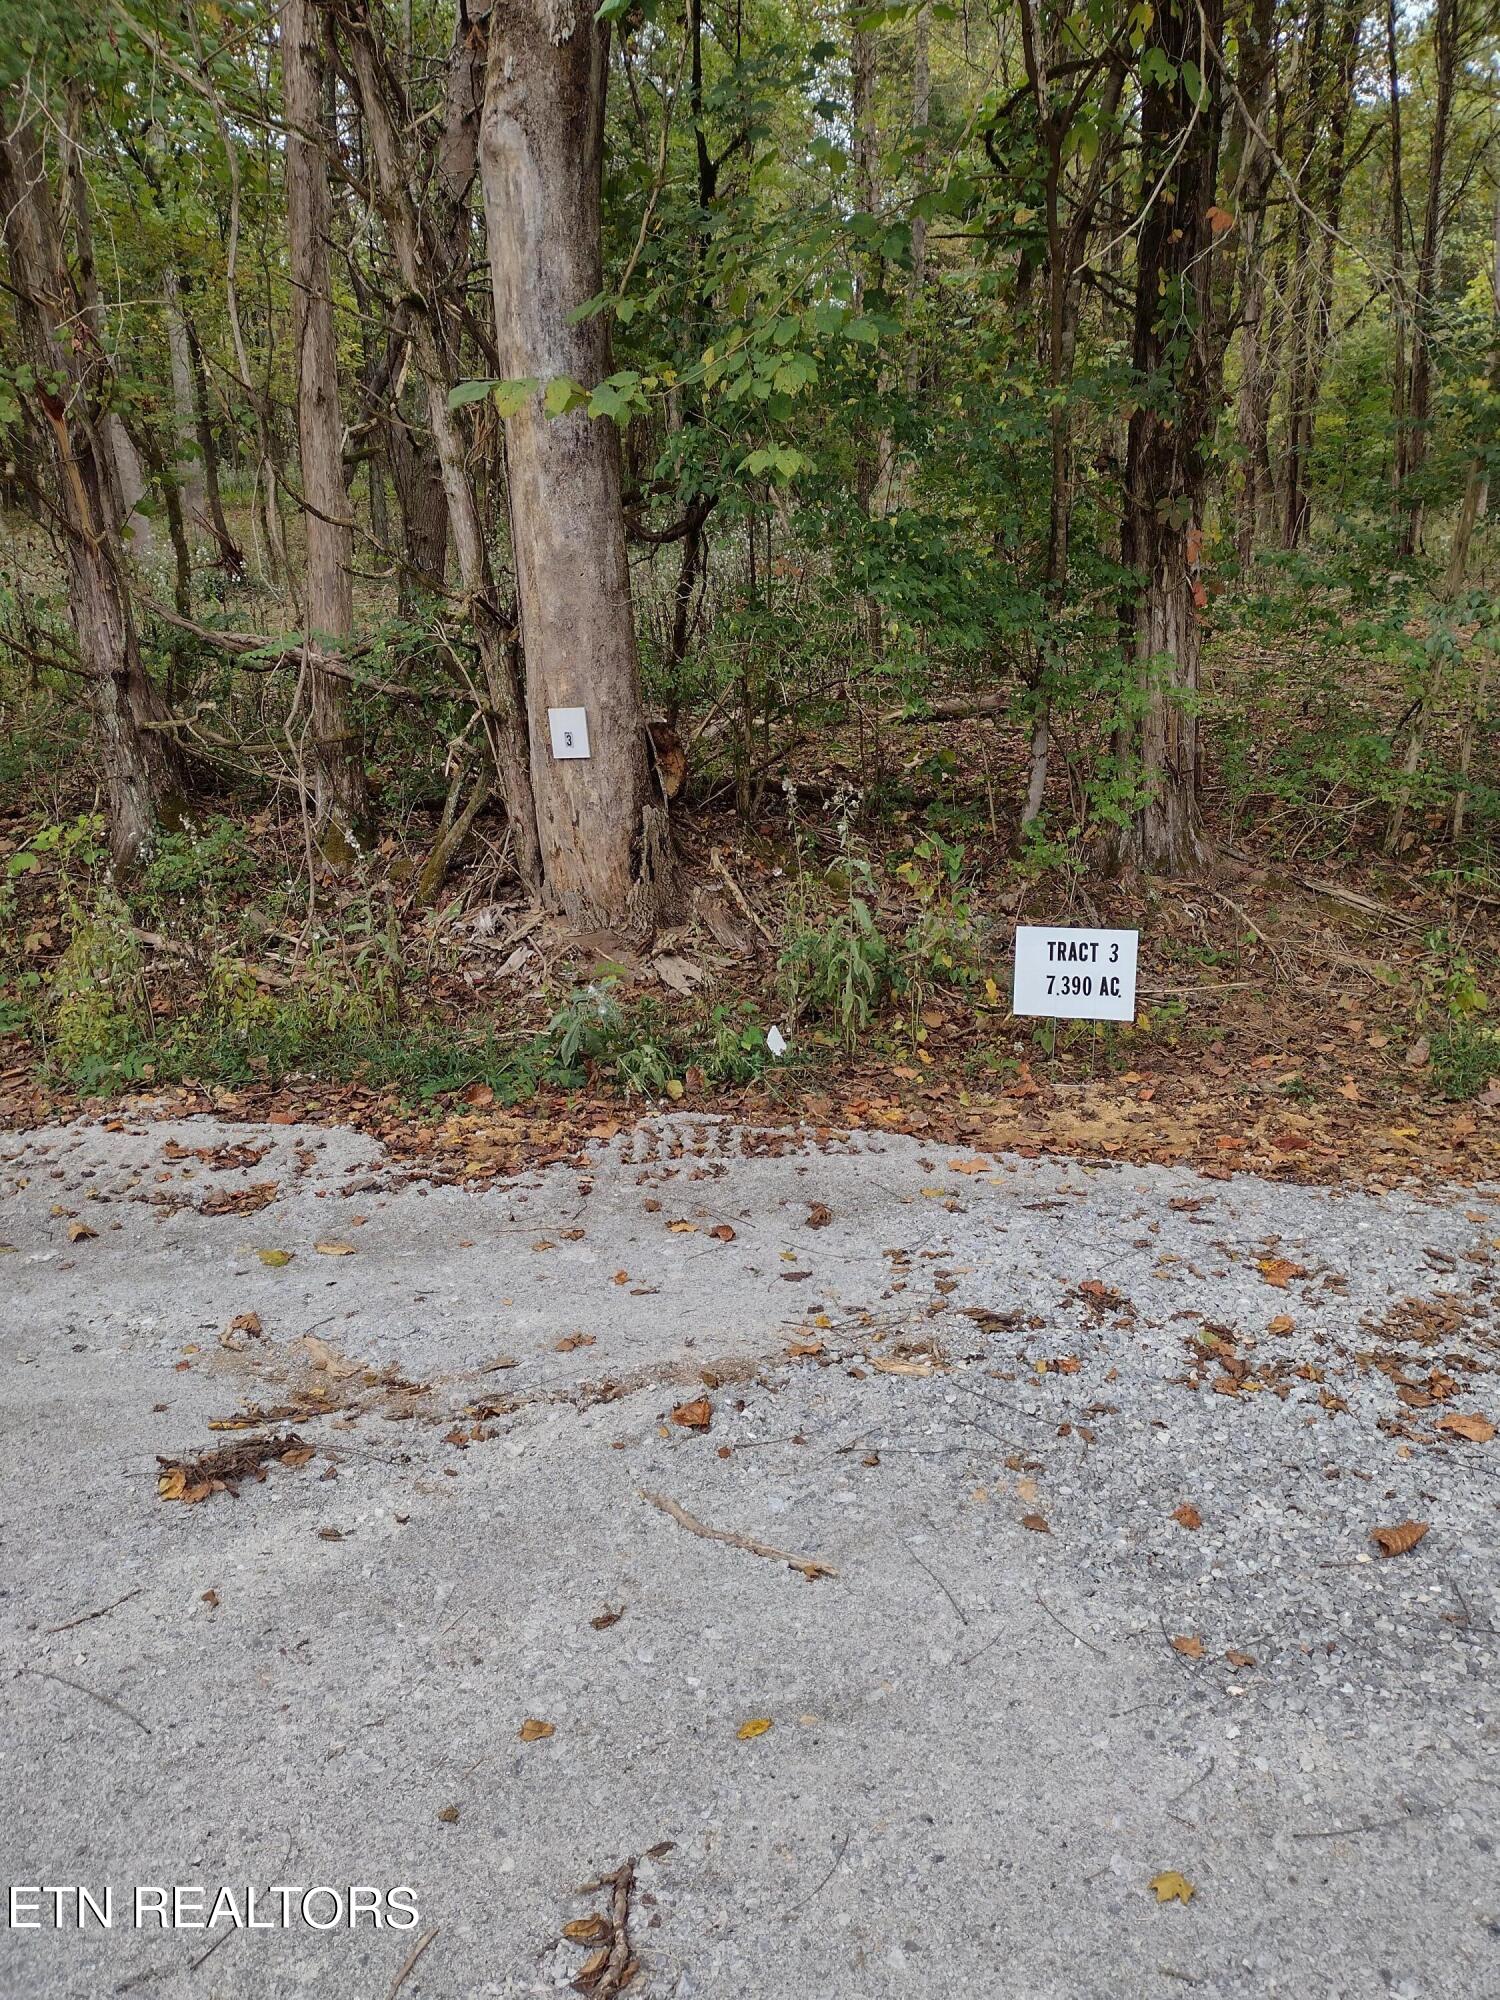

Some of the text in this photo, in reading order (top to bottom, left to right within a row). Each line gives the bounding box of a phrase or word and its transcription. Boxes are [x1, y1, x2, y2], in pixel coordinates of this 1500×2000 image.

[1047, 941, 1119, 963] TRACT 3
[1046, 975, 1122, 998] 7.390 AC.
